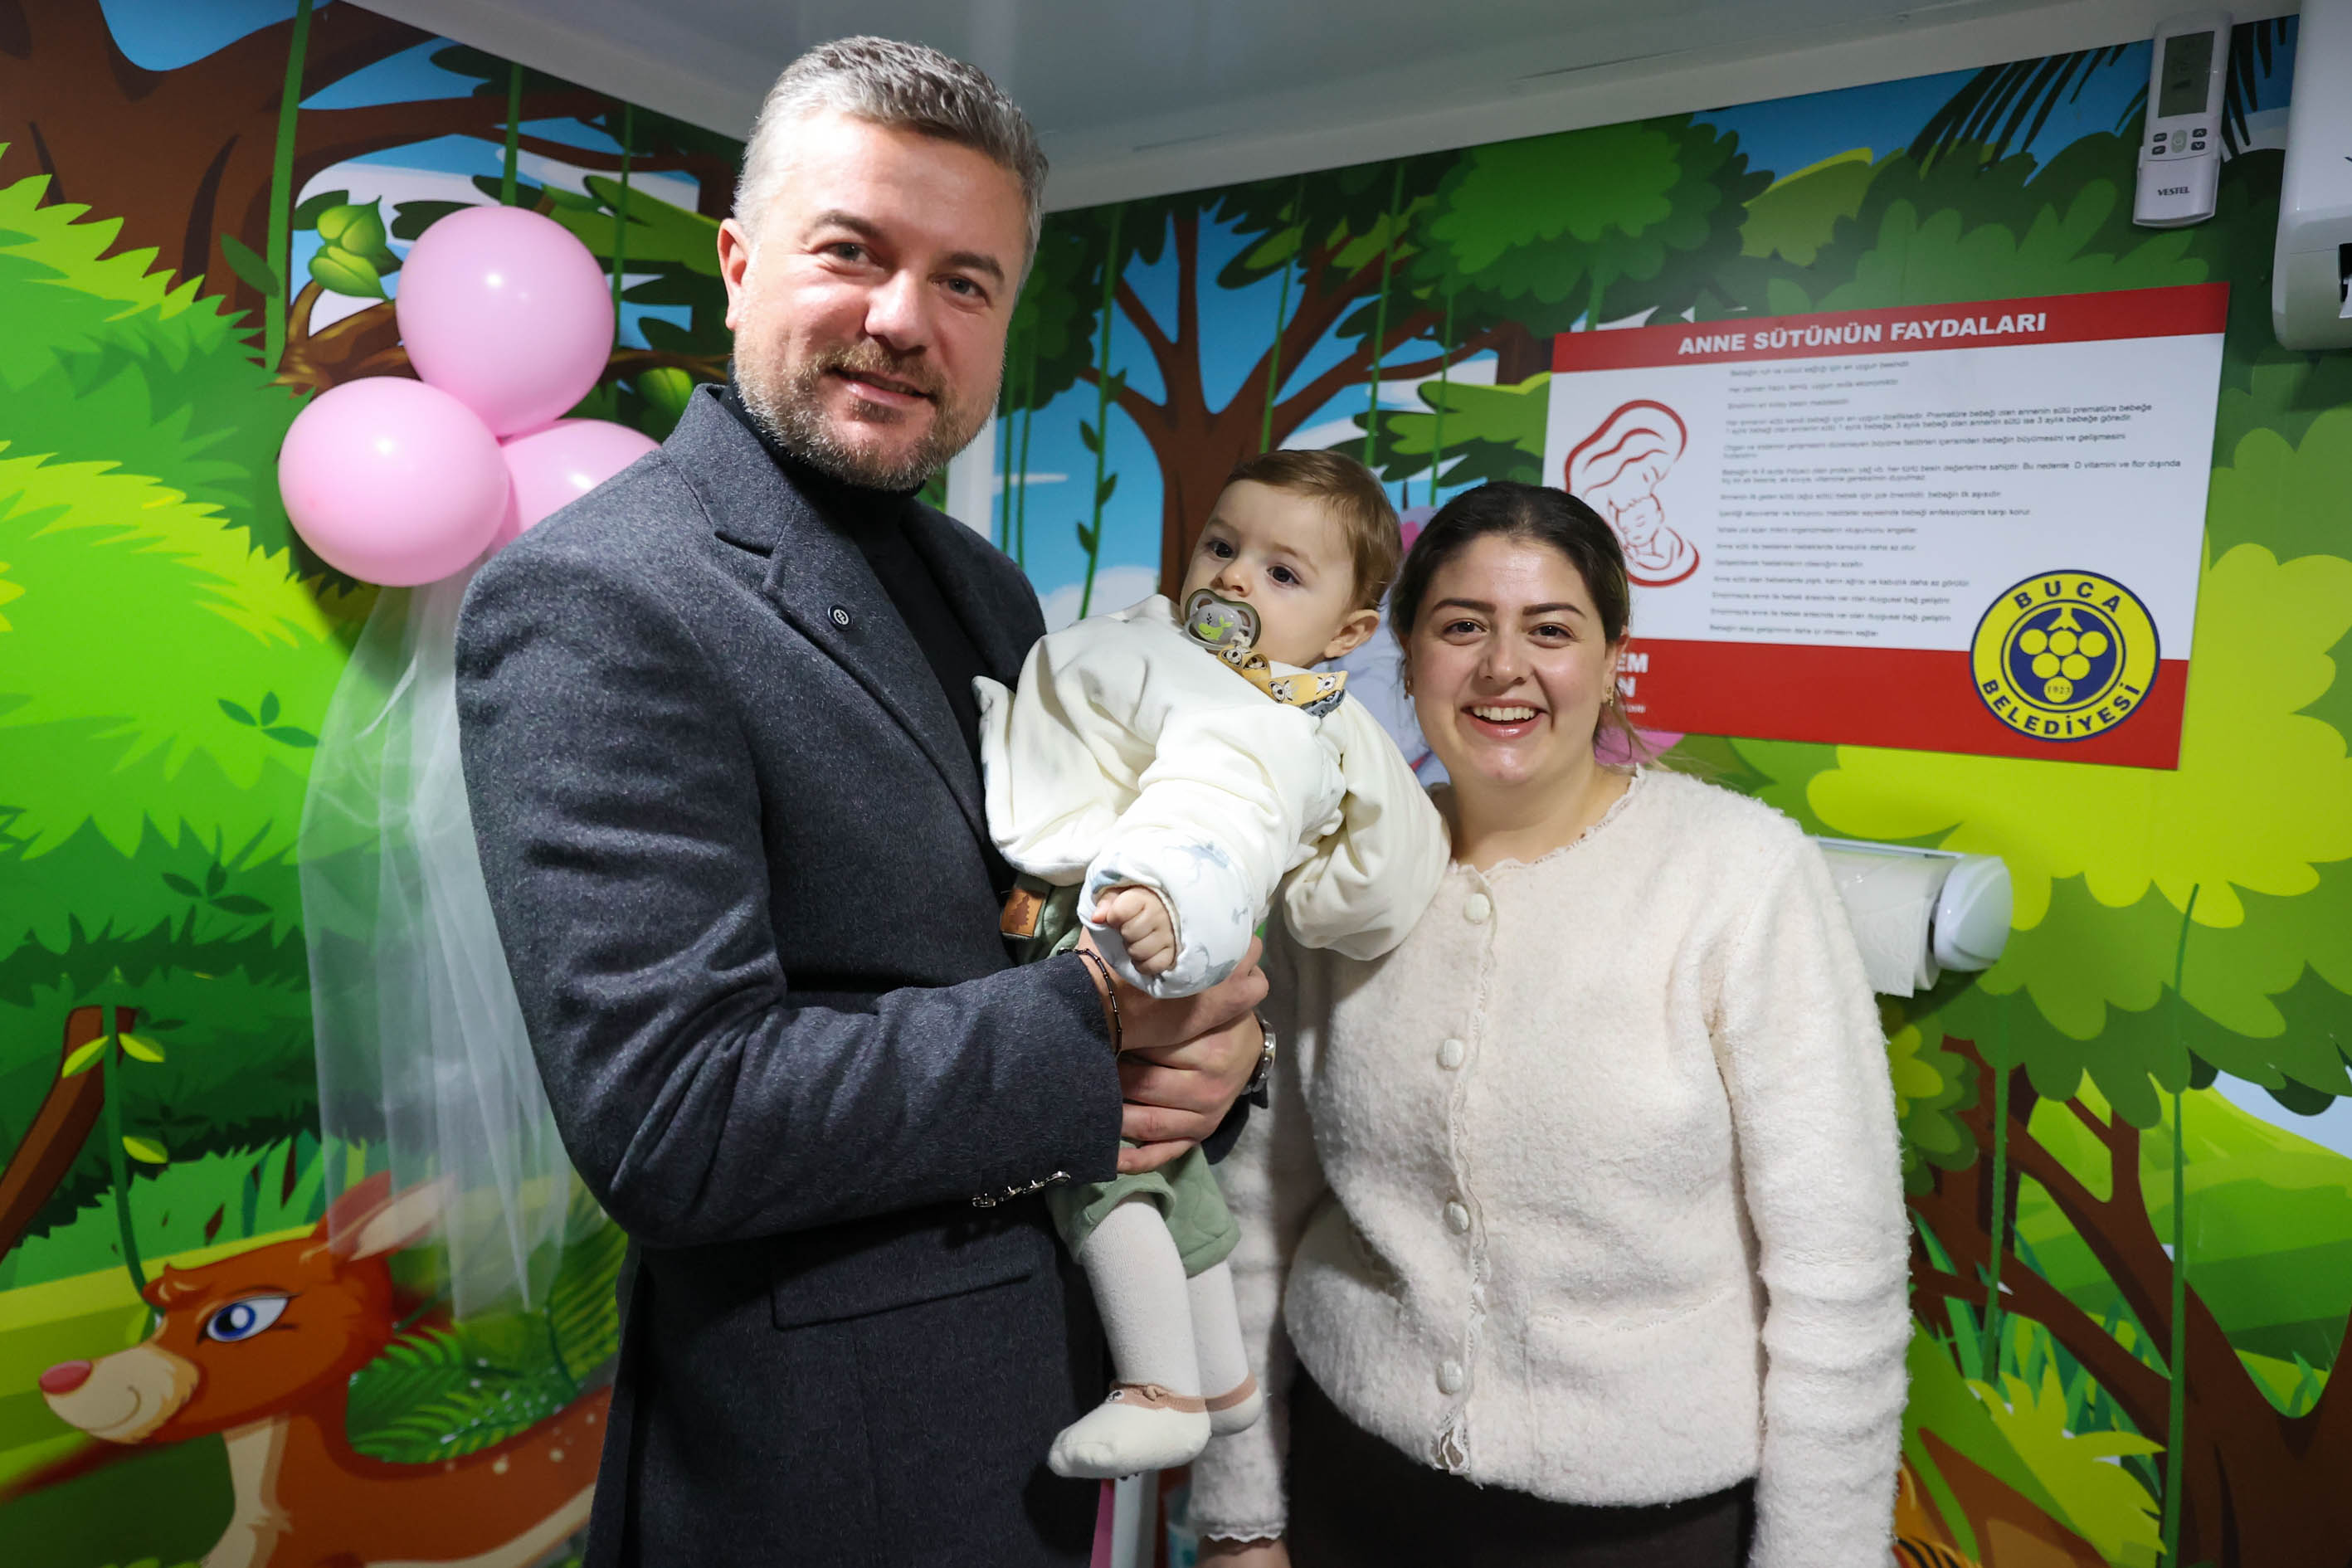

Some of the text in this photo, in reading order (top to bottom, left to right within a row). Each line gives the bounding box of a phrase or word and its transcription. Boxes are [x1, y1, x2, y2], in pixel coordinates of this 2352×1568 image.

[2157, 187, 2189, 196] VESTEL
[1678, 313, 2046, 355] ANNE SÜTÜNÜN FAYDALARI
[2014, 580, 2121, 612] BUCA
[2046, 684, 2072, 695] 1923
[1982, 679, 2140, 735] BELEDİYESİ
